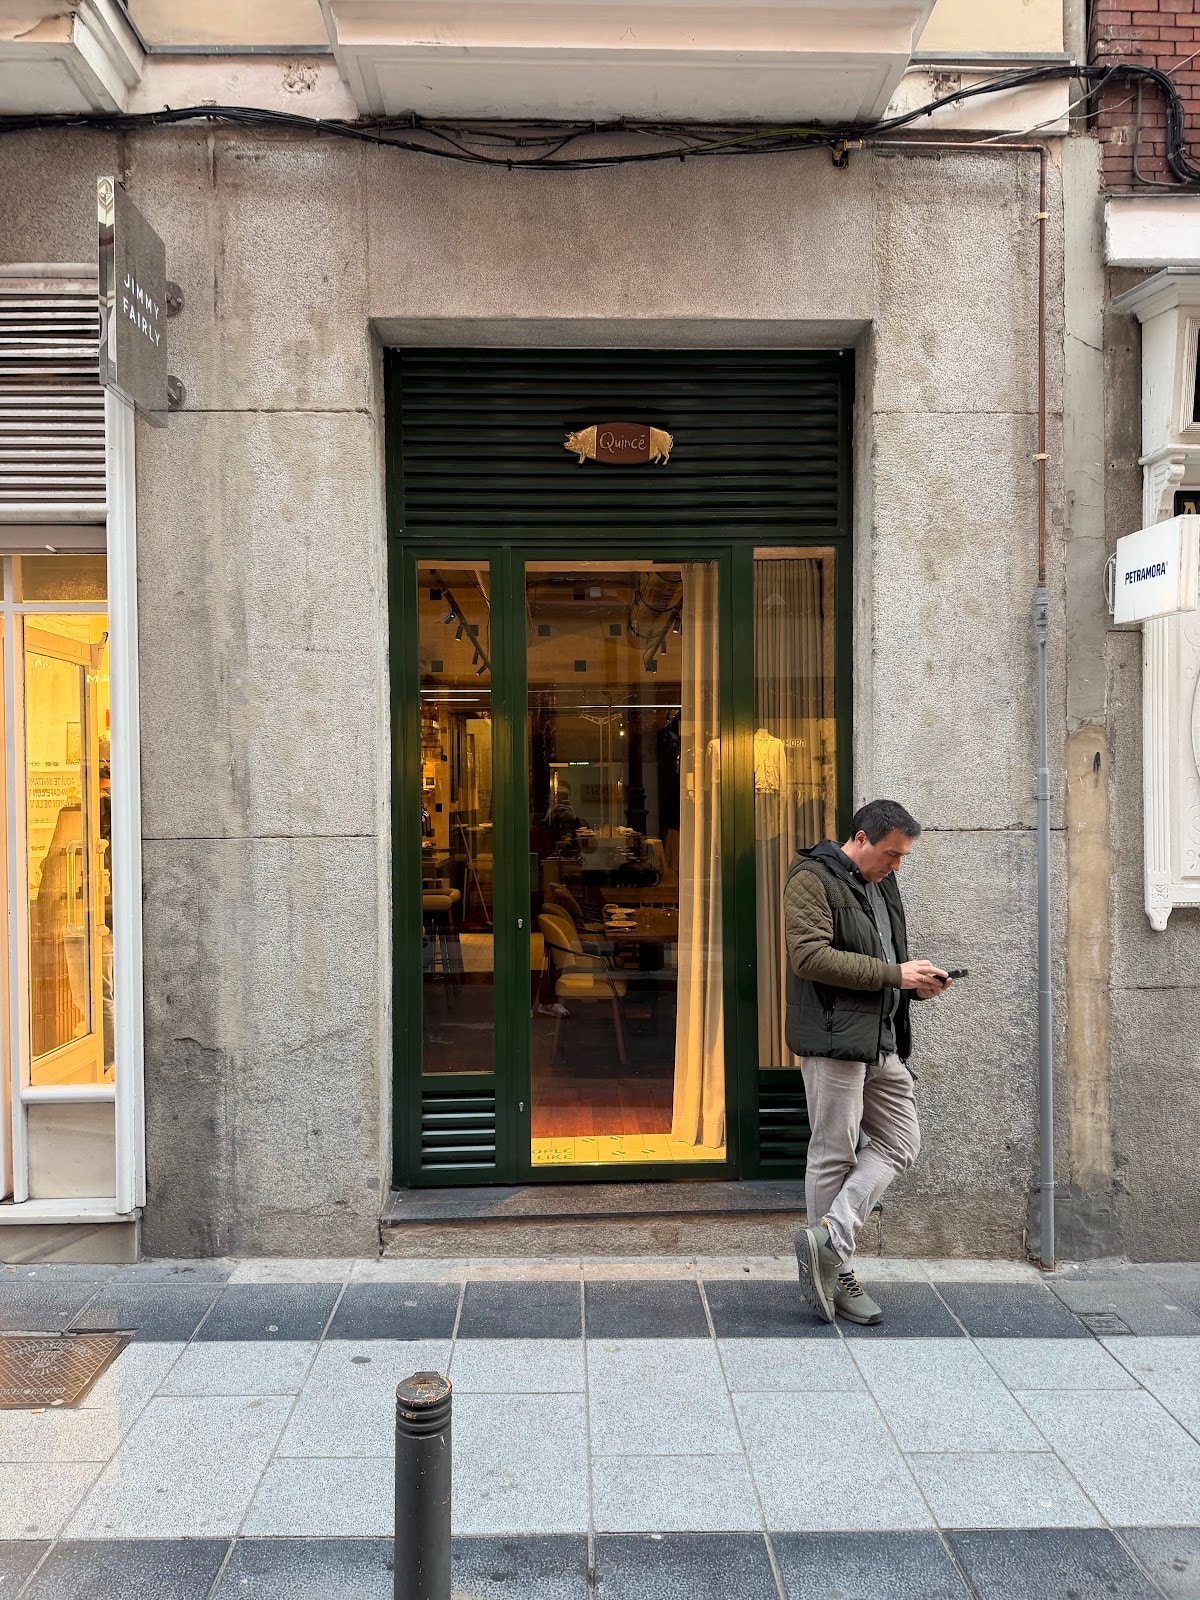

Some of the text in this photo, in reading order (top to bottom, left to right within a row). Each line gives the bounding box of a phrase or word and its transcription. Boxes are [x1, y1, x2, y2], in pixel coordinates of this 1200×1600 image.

[123, 273, 160, 320] JIMMY
[123, 299, 161, 347] FAIRLY
[599, 431, 647, 454] Quincé
[532, 1147, 573, 1155] OPLE
